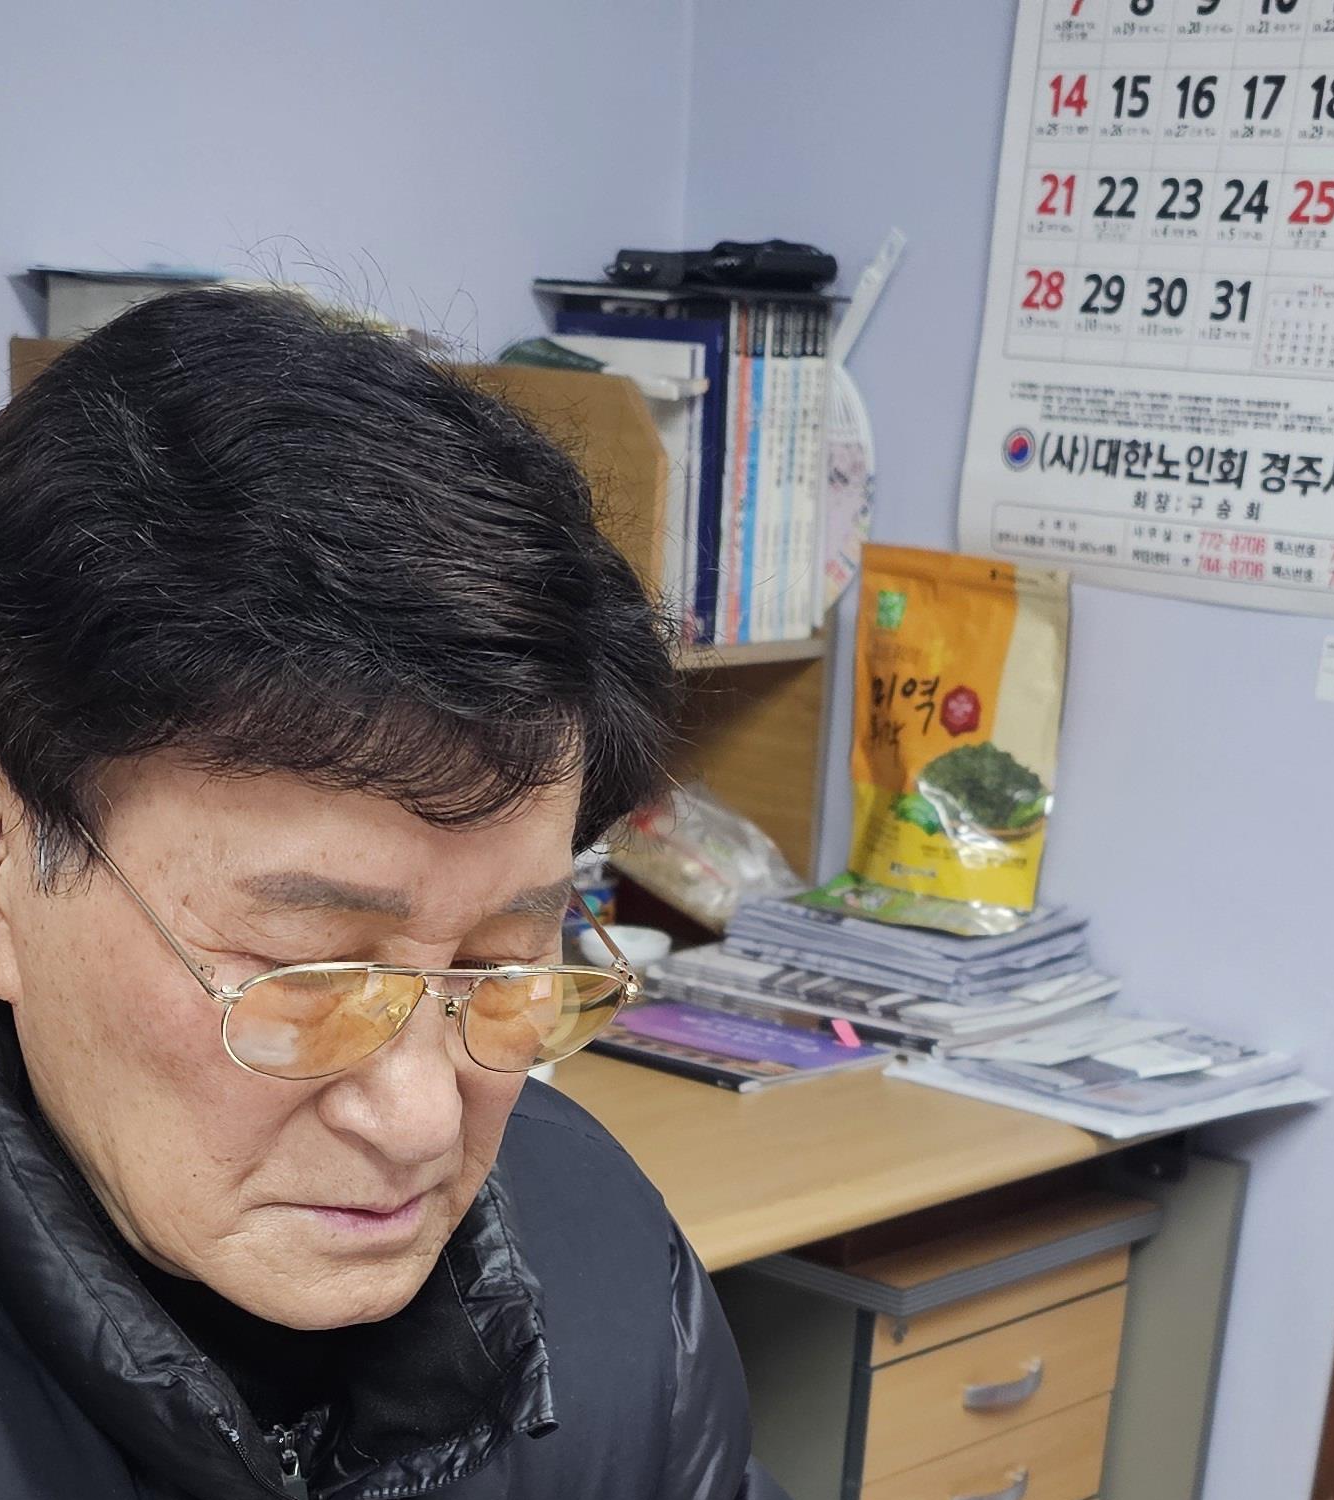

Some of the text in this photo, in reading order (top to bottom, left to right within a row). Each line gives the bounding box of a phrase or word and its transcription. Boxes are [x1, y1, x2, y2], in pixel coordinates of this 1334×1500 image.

[1049, 73, 1089, 118] 14
[1111, 75, 1152, 119] 15
[1176, 75, 1218, 119] 16
[1242, 75, 1286, 120] 17
[1036, 173, 1076, 215] 21
[1093, 176, 1139, 219] 22
[1155, 177, 1203, 221] 23
[1219, 178, 1269, 223] 24
[1021, 269, 1252, 323] 28 29 30 31
[1039, 432, 1247, 489] (사)대한노인회
